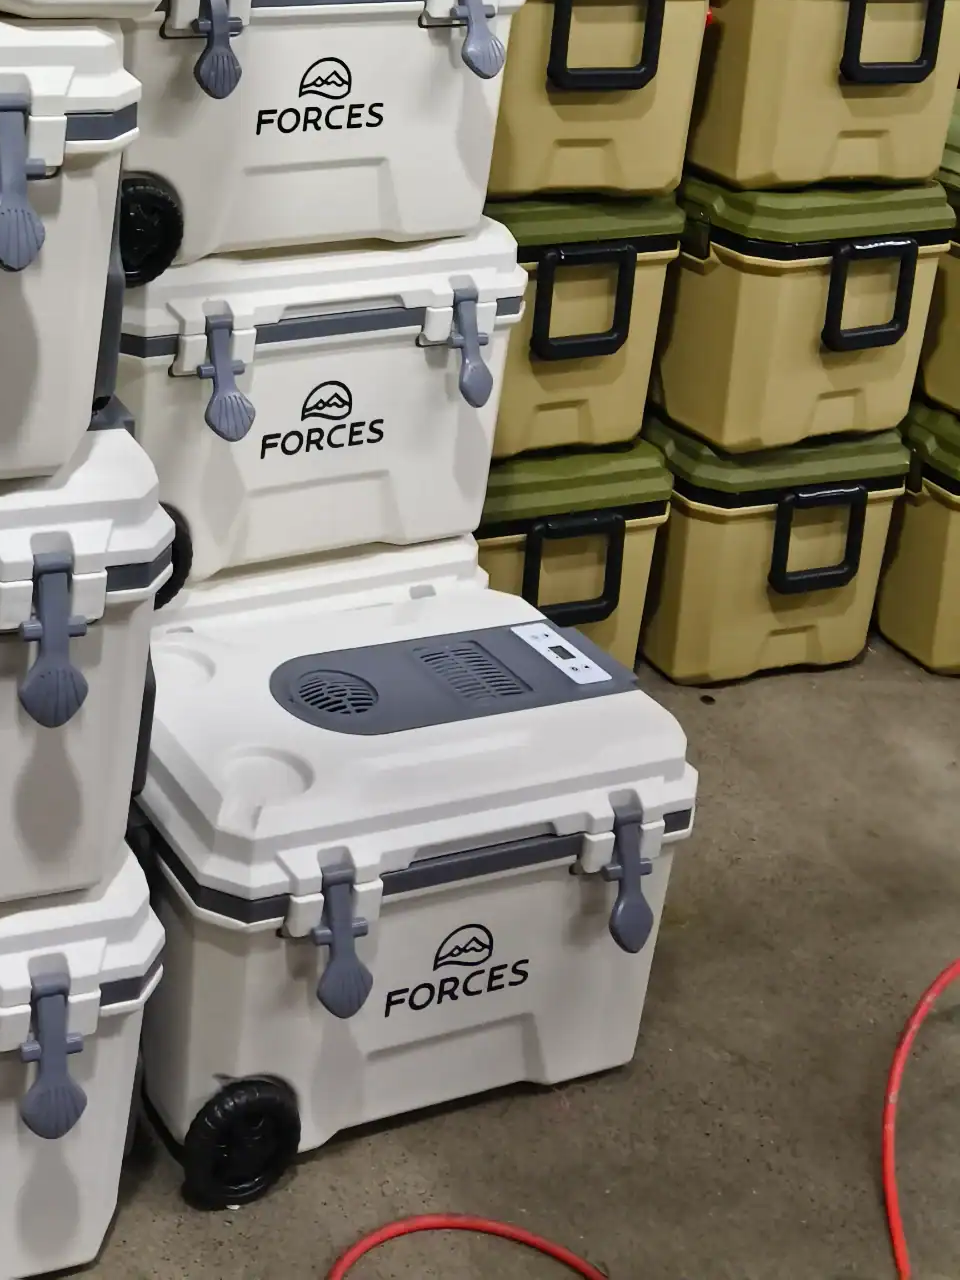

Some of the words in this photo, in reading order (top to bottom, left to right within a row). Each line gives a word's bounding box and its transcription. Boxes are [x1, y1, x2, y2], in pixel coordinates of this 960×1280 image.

[255, 102, 384, 136] FORCES
[260, 418, 384, 460] FORCES
[384, 957, 530, 1018] FORCES
